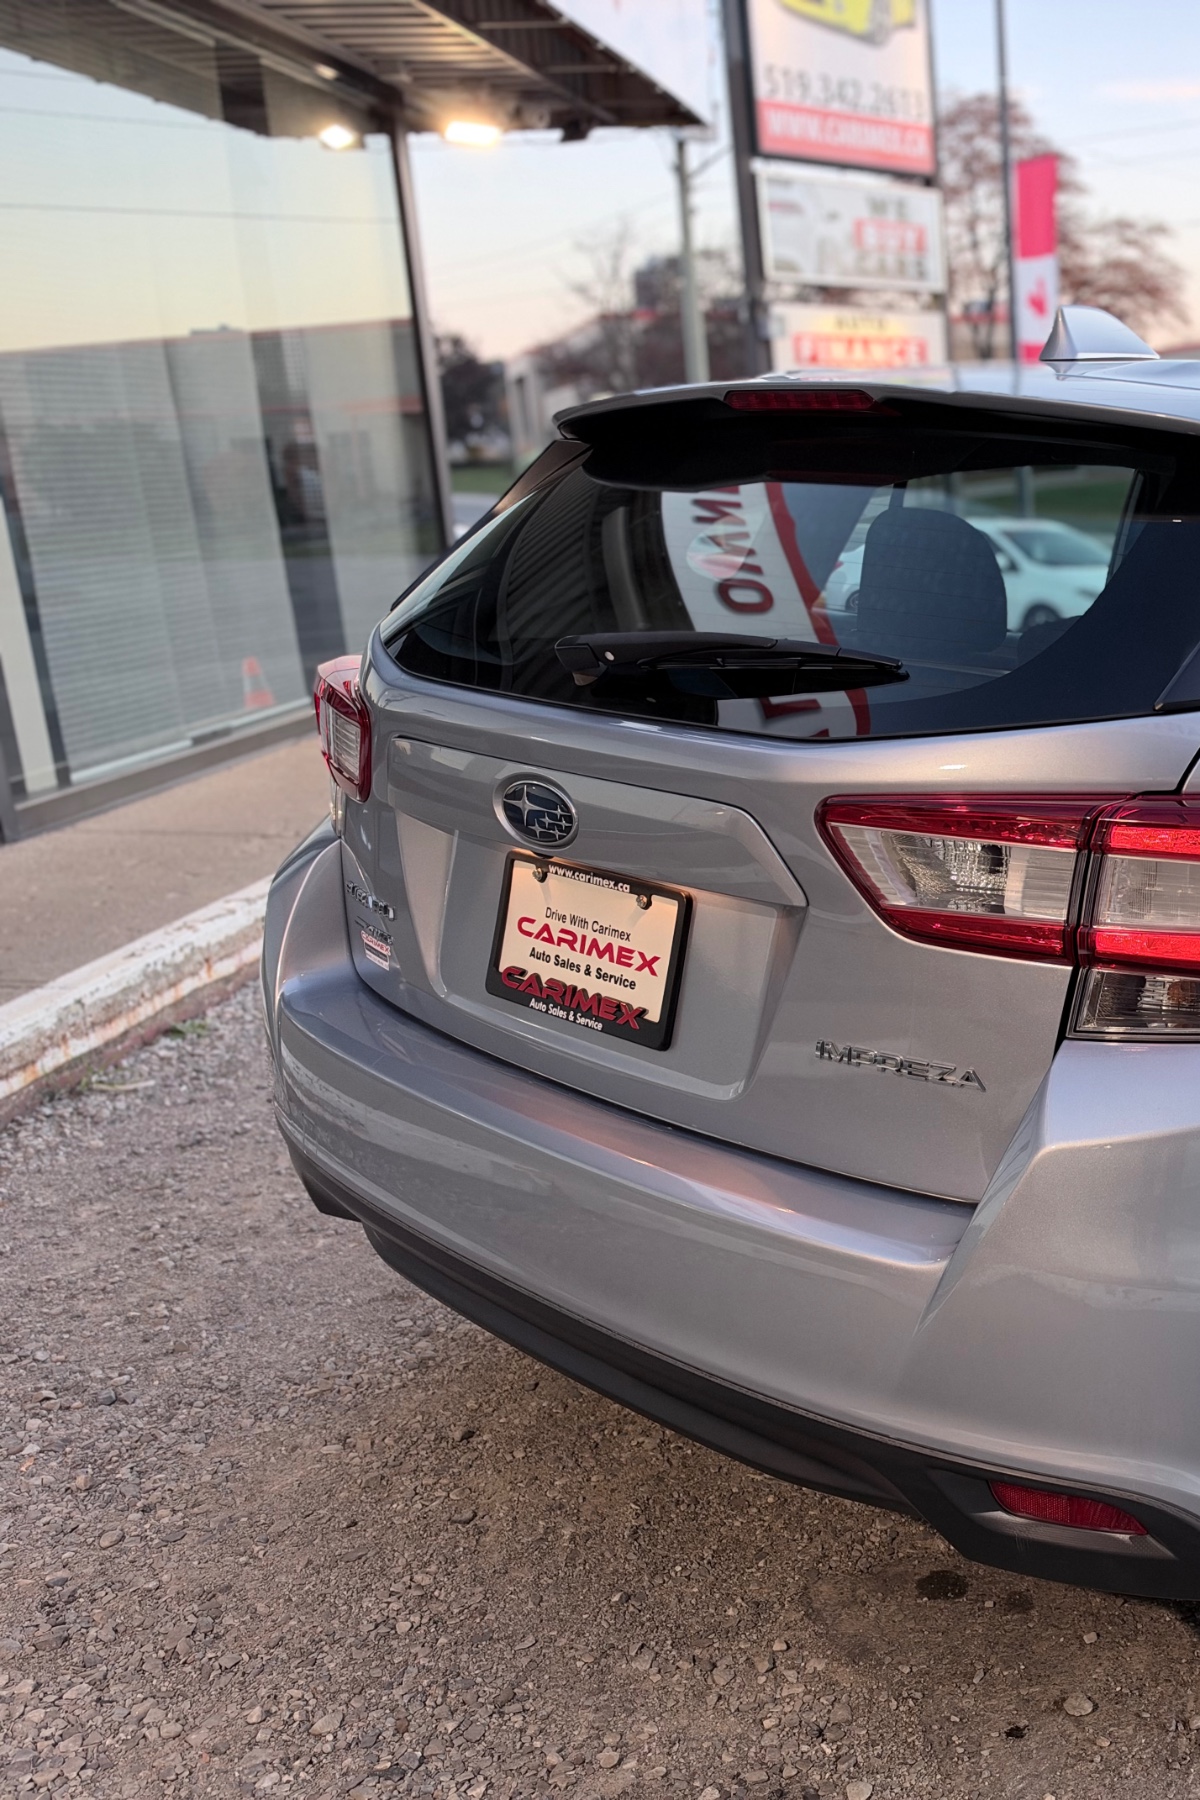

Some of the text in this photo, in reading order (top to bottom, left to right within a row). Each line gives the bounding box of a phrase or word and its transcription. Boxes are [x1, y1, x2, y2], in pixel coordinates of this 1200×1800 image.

[548, 864, 631, 893] www.carimex.ca
[545, 906, 632, 942] Drive With Carimex
[517, 916, 661, 977] CARIMEX
[529, 946, 637, 990] Auto Sales & Service
[501, 965, 645, 1030] CARIMEX
[529, 997, 603, 1031] Auto Sales & Service
